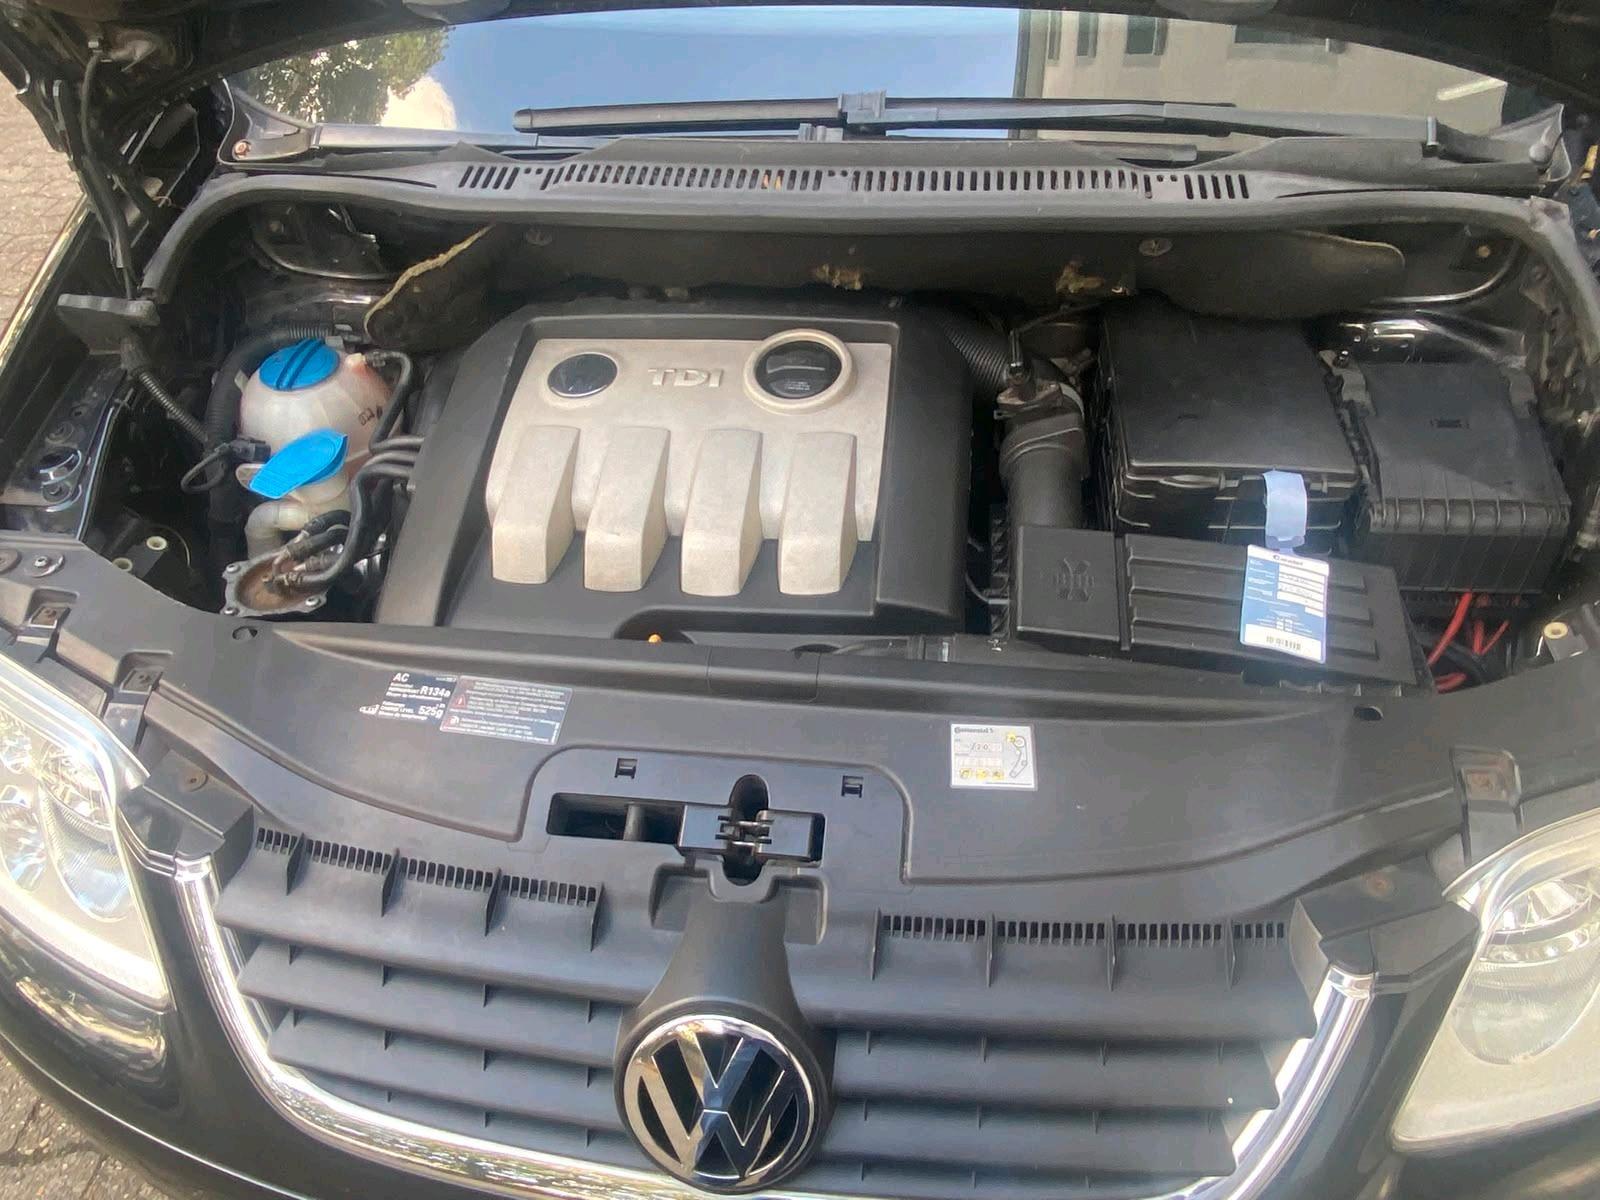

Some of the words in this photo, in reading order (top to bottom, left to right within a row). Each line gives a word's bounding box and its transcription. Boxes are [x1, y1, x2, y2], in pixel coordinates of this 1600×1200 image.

[647, 367, 724, 388] TDI
[392, 673, 410, 682] AC
[420, 685, 451, 698] R134a
[418, 705, 444, 719] 525g
